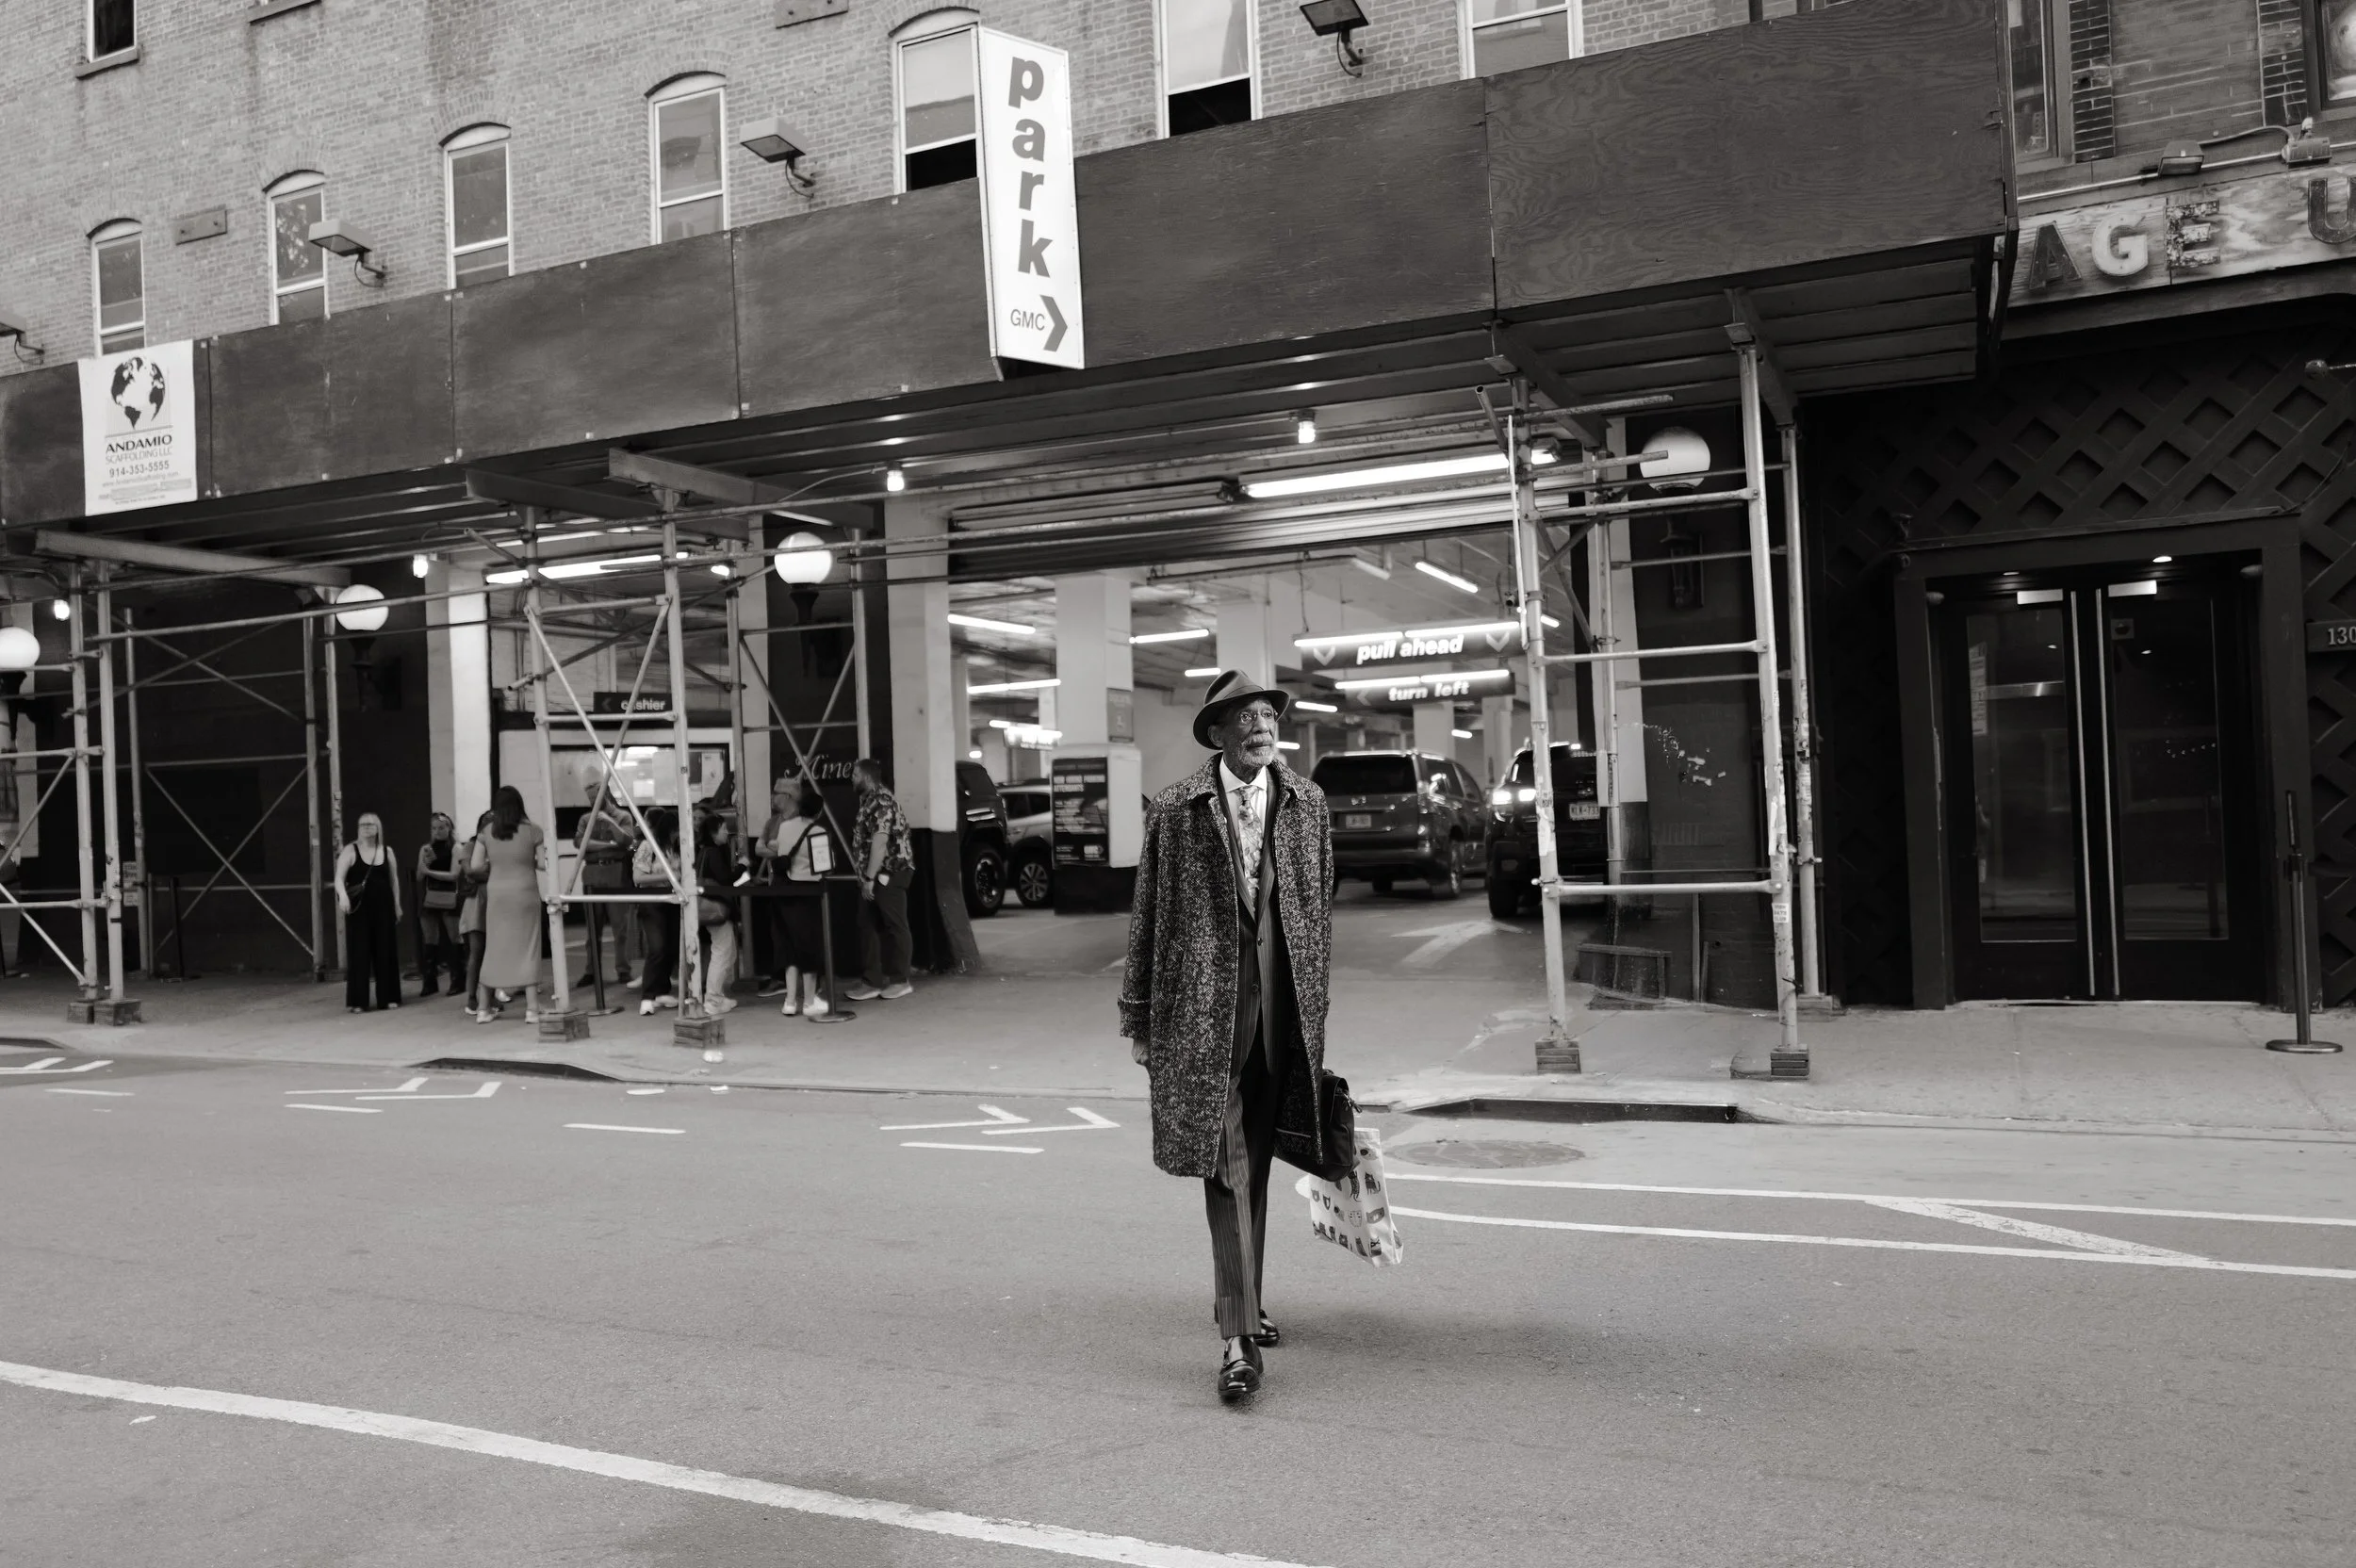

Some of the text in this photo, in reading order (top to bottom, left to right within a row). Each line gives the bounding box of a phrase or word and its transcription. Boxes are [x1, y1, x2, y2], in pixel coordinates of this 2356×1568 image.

[1008, 56, 1054, 278] park
[1010, 309, 1046, 331] GMC
[106, 434, 172, 453] ANDAMIO
[106, 447, 172, 465] SCAFFOLDING LLC
[109, 460, 170, 478] 914-353-5555
[1356, 634, 1464, 664] pull ahead
[1388, 680, 1470, 701] turn left
[620, 698, 665, 710] cshier
